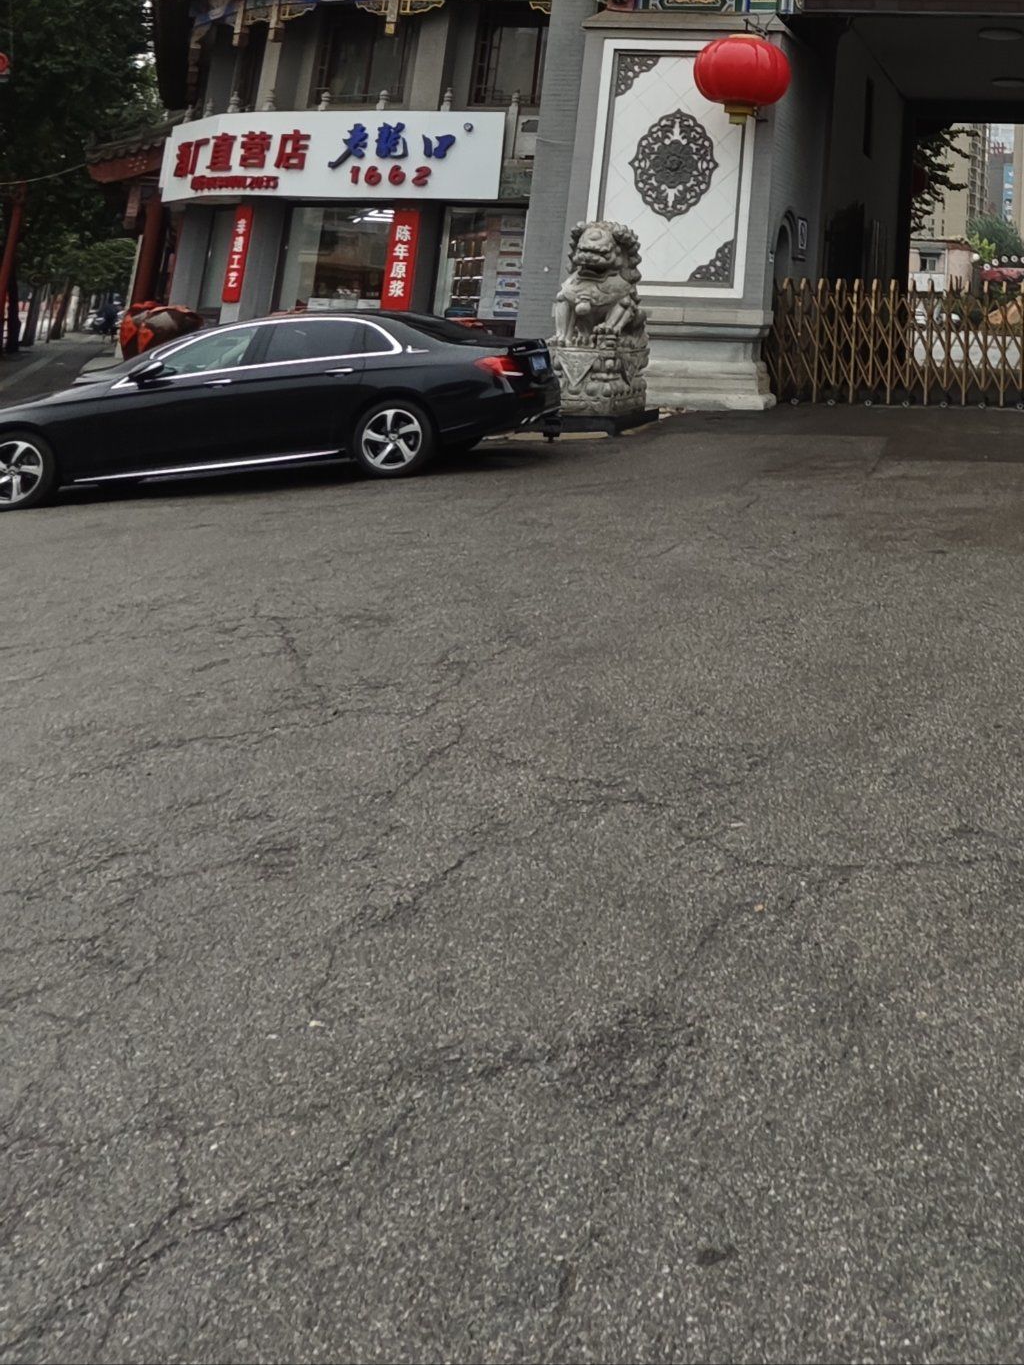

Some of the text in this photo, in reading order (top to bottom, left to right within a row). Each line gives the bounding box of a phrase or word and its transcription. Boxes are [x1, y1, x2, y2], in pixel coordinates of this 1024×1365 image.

[350, 165, 432, 186] 1662
[388, 224, 412, 298] 陈年原浆
